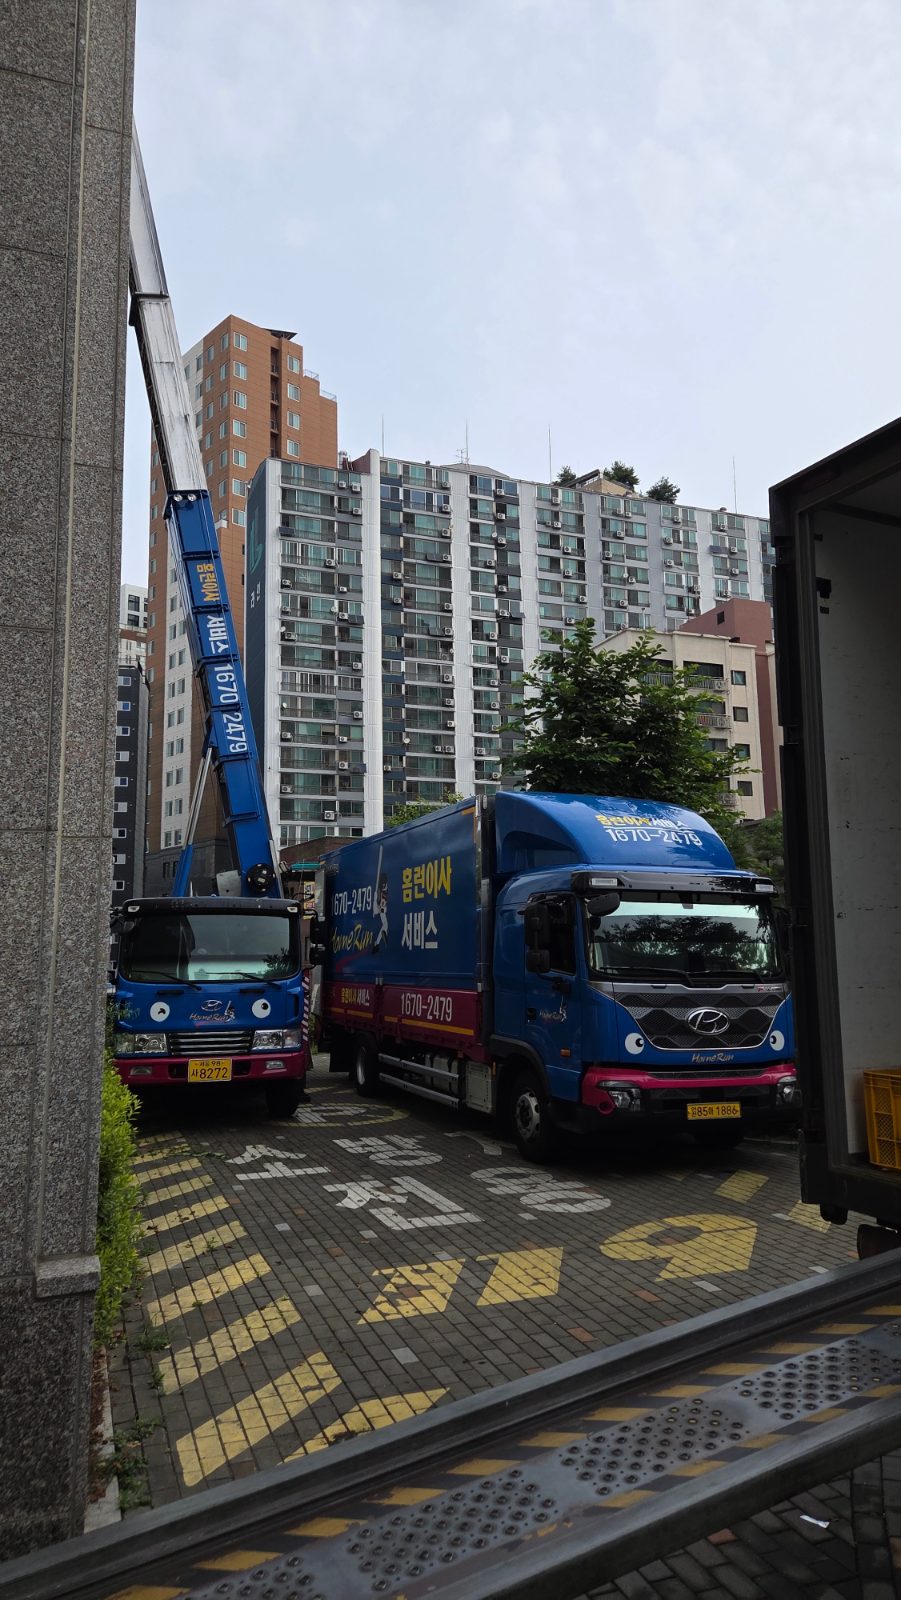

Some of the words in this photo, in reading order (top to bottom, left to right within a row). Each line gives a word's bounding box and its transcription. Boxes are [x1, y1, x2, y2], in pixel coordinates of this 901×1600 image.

[196, 563, 220, 602] 홈런이사
[207, 615, 229, 655] 서비스
[214, 663, 239, 703] 1670
[223, 712, 247, 753] 2479
[605, 828, 703, 846] 1670-2479
[402, 856, 453, 903] 홈런이사
[401, 910, 439, 951] 서비스
[401, 993, 453, 1022] 1670-2479
[715, 1104, 737, 1115] 1886
[322, 1166, 612, 1231] 전용
